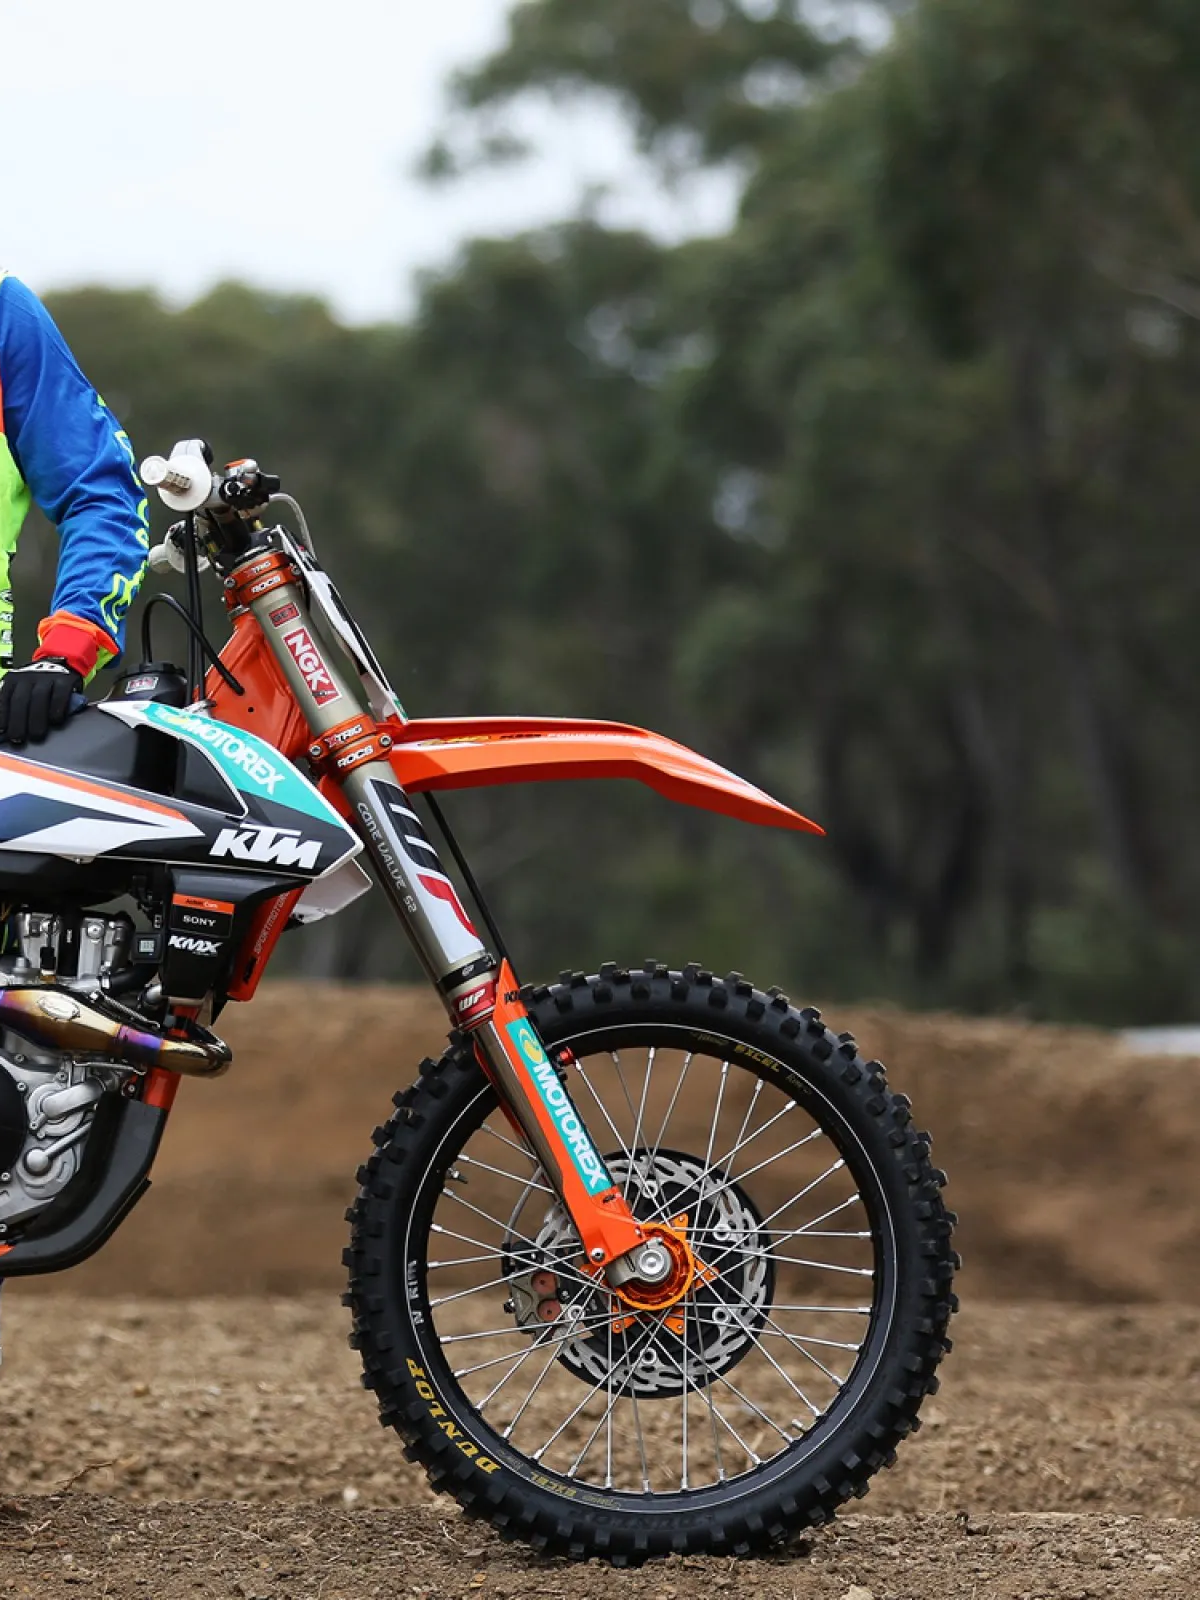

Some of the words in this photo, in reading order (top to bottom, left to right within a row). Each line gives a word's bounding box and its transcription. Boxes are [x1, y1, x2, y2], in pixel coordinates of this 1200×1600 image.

[287, 633, 330, 691] NGK
[187, 717, 285, 795] MOTOREX
[209, 822, 323, 870] KTM
[167, 935, 223, 953] KMX
[183, 914, 217, 927] SONY
[533, 1063, 608, 1189] MOTOREX
[406, 1357, 502, 1475] DUNLOP
